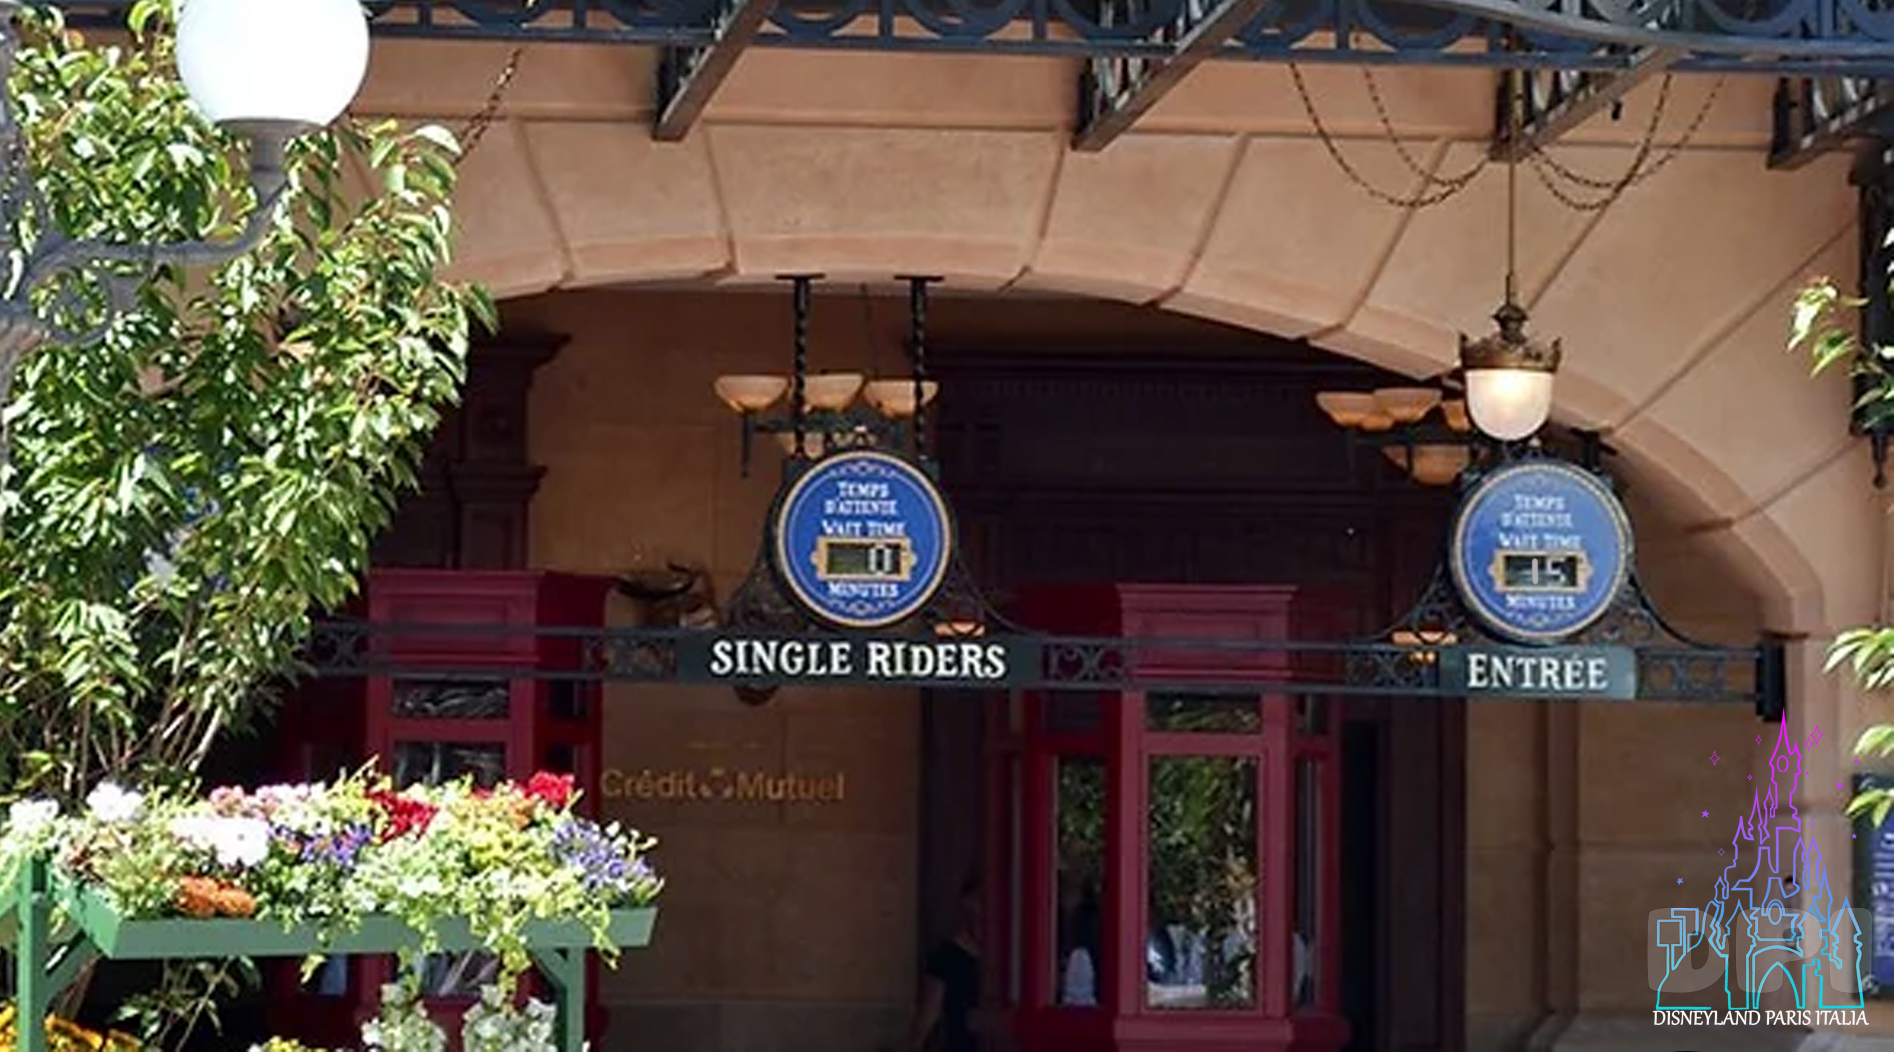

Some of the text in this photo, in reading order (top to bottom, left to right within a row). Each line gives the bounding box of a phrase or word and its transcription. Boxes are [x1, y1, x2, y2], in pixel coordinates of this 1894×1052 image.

[837, 481, 890, 497] TEMPS
[1514, 494, 1566, 510] TEMPS
[822, 520, 906, 536] WAIT TIME
[1499, 533, 1582, 549] WAIT TIME
[827, 581, 899, 598] MINUTES
[1505, 594, 1576, 610] MINUTES
[710, 640, 1006, 678] SINGLE RIDERS
[1467, 652, 1609, 691] ENTRÉE
[601, 768, 845, 799] Crédit Mutuel
